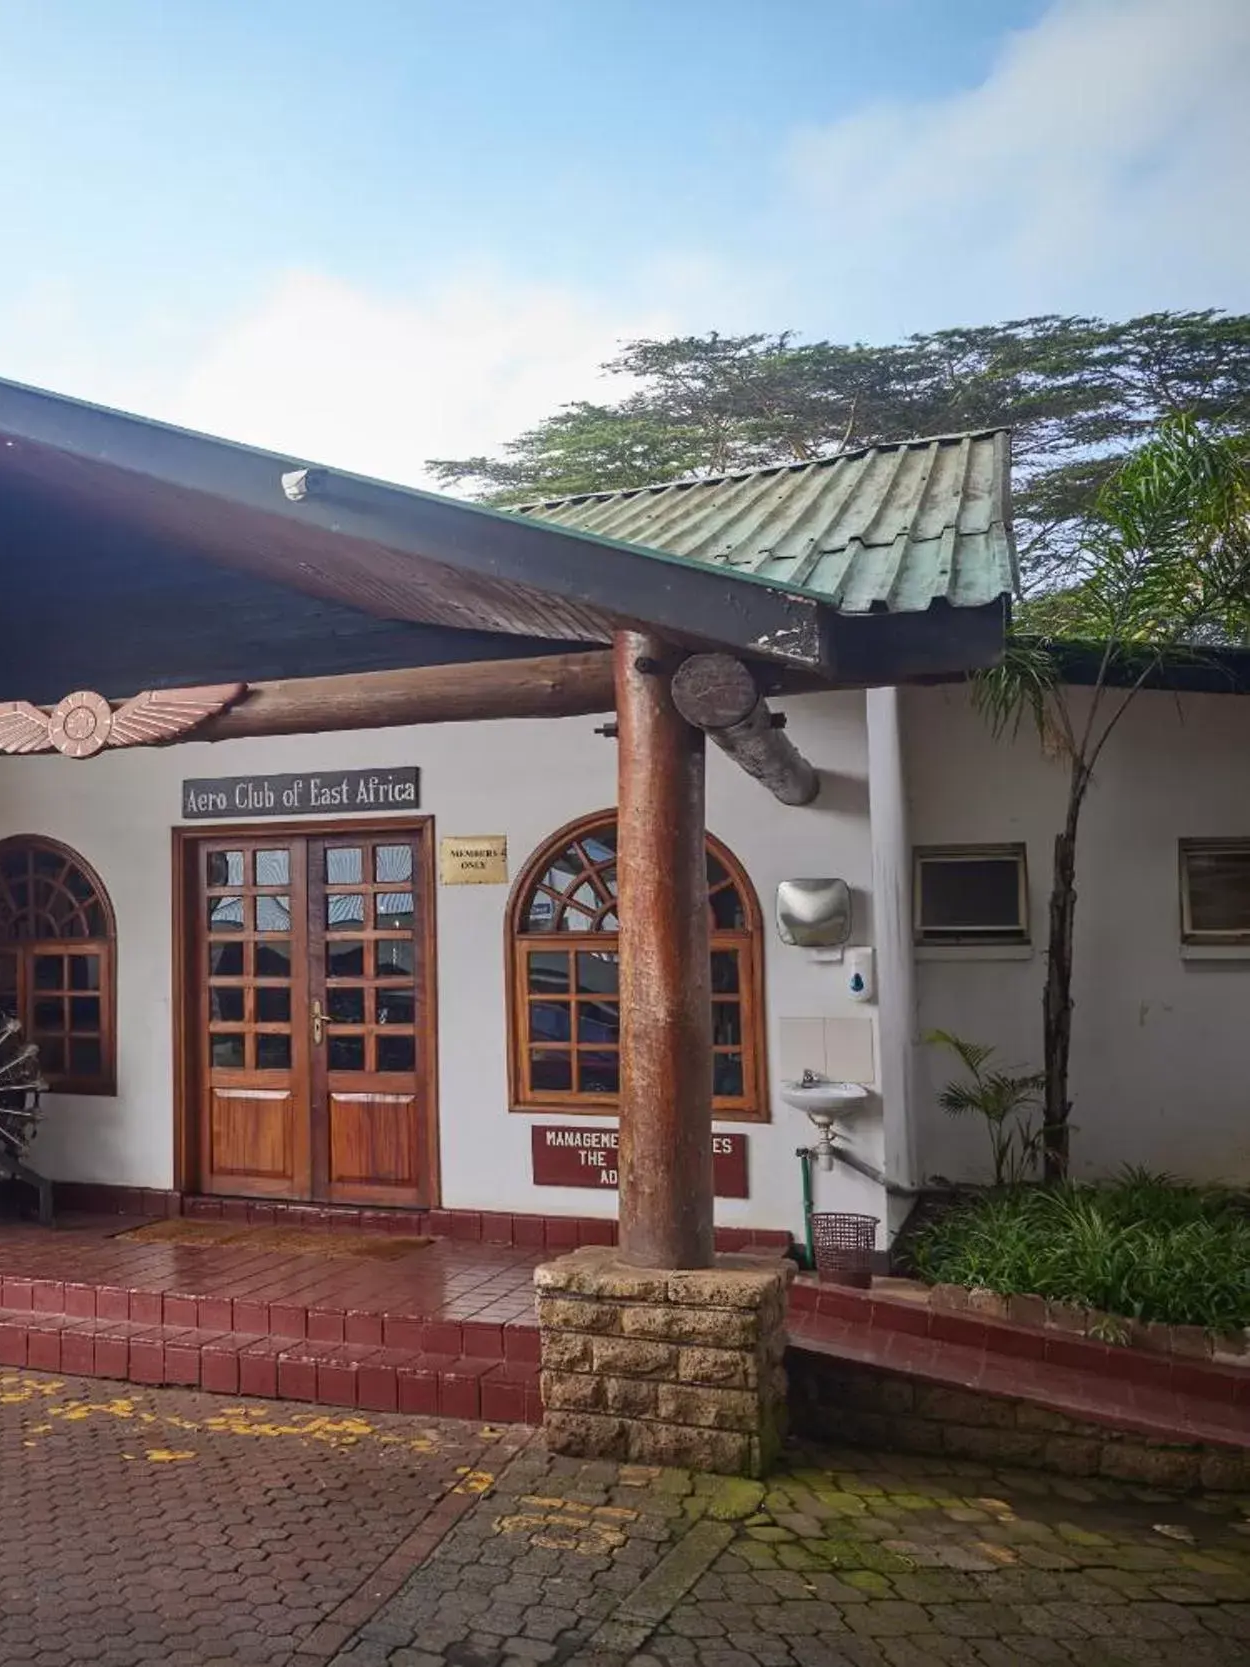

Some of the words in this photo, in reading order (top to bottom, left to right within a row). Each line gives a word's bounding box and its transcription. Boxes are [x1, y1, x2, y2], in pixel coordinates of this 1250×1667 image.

[187, 789, 227, 812] Aero
[236, 781, 274, 809] Club
[282, 779, 303, 806] of
[310, 778, 350, 806] East
[356, 775, 415, 804] Africa
[546, 1131, 619, 1149] MANAGEME
[578, 1151, 607, 1166] THE
